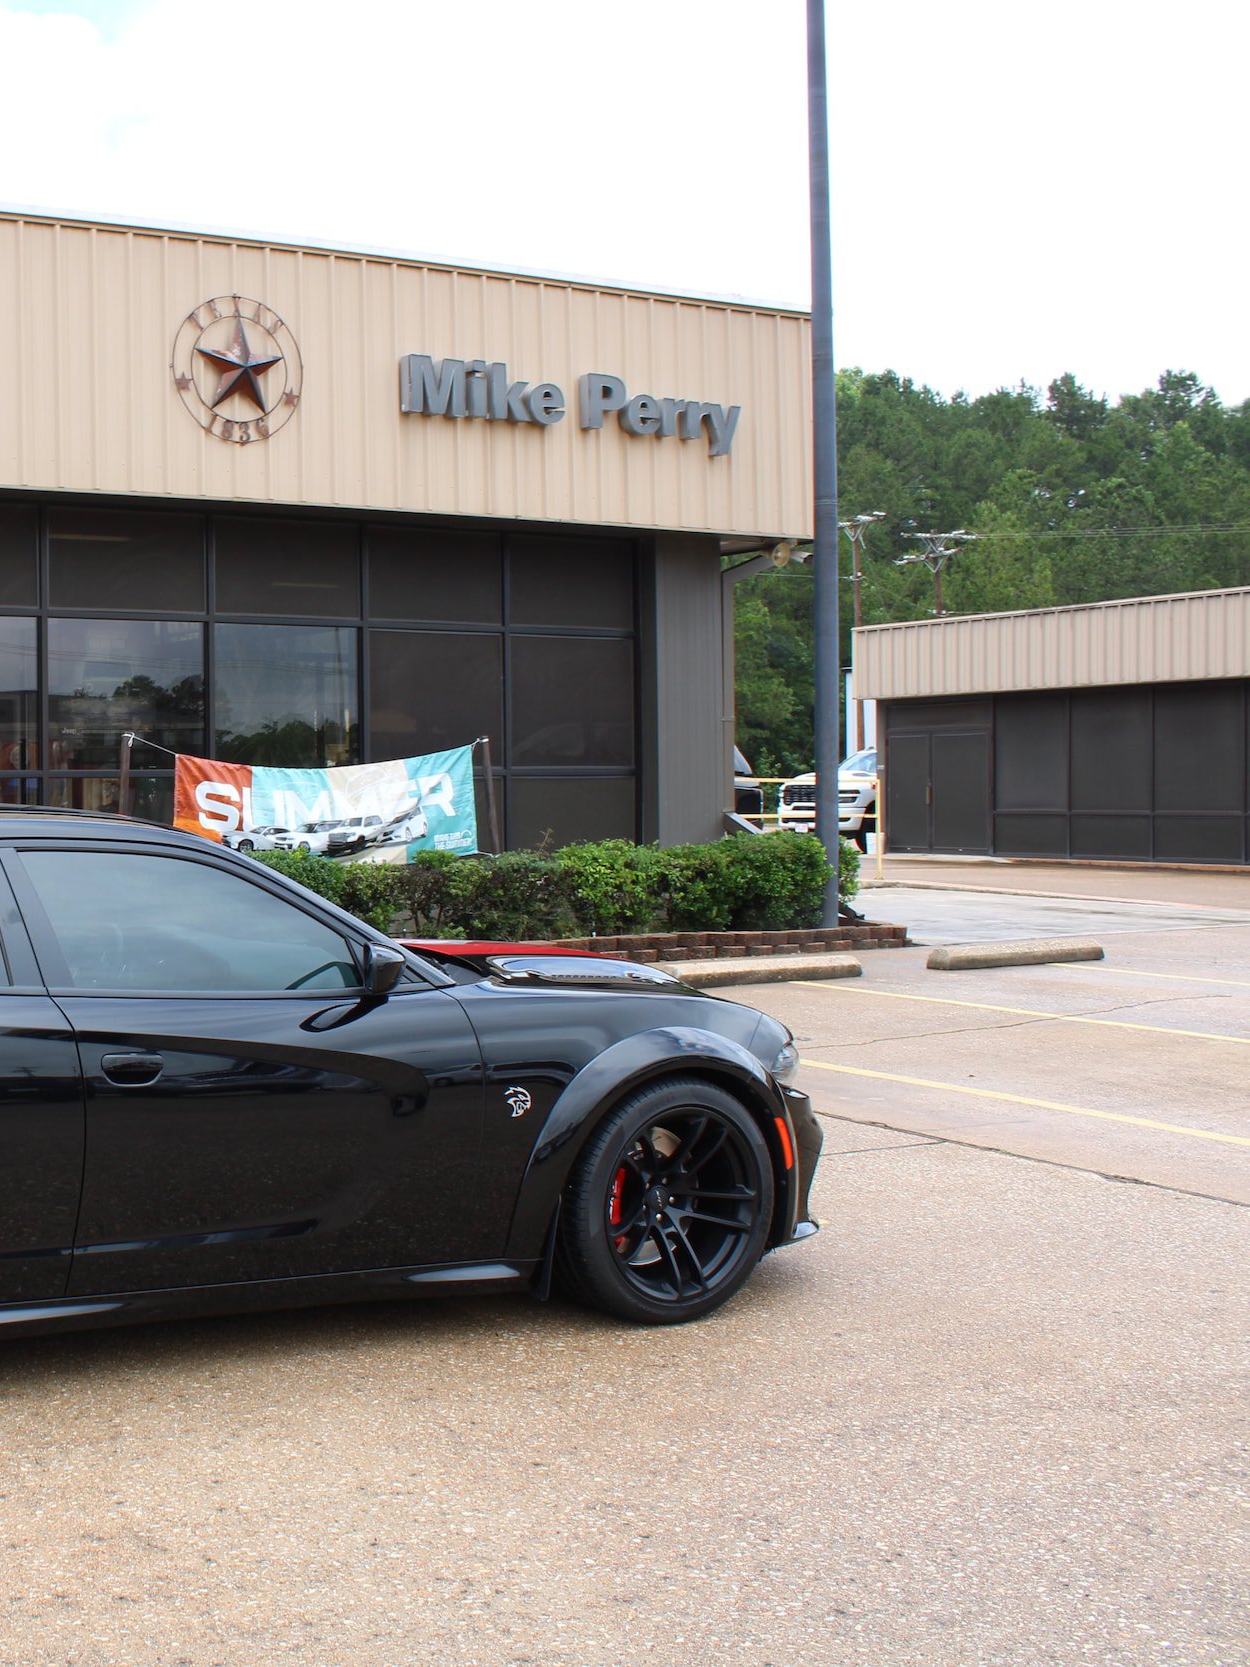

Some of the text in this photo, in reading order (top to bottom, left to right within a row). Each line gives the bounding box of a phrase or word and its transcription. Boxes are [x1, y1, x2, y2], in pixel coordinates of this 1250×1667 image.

[205, 413, 269, 443] 1836
[400, 353, 742, 457] Mike Perry
[195, 772, 457, 833] SUMMER
